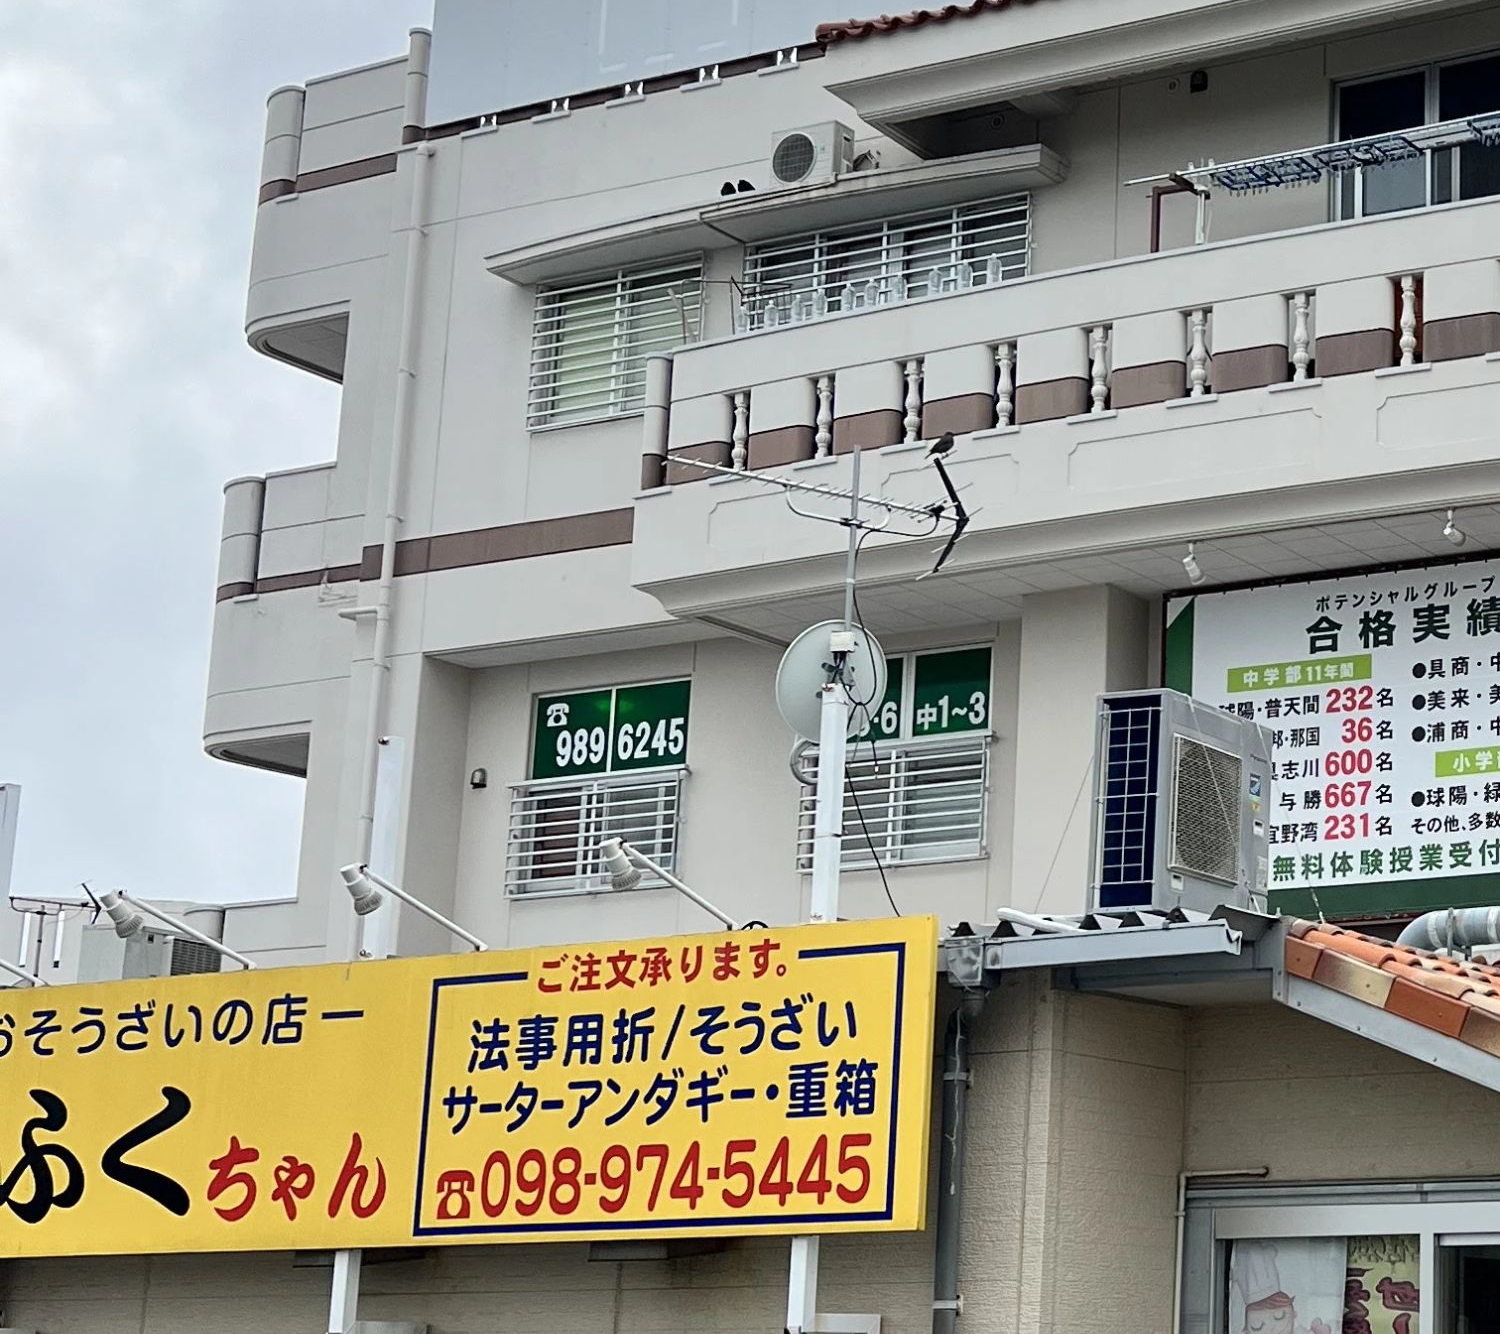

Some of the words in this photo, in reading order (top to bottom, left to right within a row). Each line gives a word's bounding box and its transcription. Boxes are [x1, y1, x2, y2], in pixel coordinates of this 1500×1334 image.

[1316, 574, 1496, 613] ポテンシャルグループ
[1242, 662, 1354, 688] 中学部11年間
[1325, 685, 1394, 714] 232名
[556, 726, 606, 767] 989
[616, 717, 685, 761] 6245
[1341, 716, 1394, 744] 36名
[1324, 748, 1394, 778] 600名
[1279, 790, 1322, 812] 与勝
[1323, 780, 1394, 809] 667名
[1323, 812, 1394, 841] 231名
[537, 938, 788, 993] ご注文承ります。
[467, 992, 857, 1073] 法事用折/そうざい
[442, 1057, 878, 1135] サーターアンダギー・重箱
[0, 1086, 387, 1224] ふくちゃん
[481, 1133, 872, 1219] 098-974-5445
